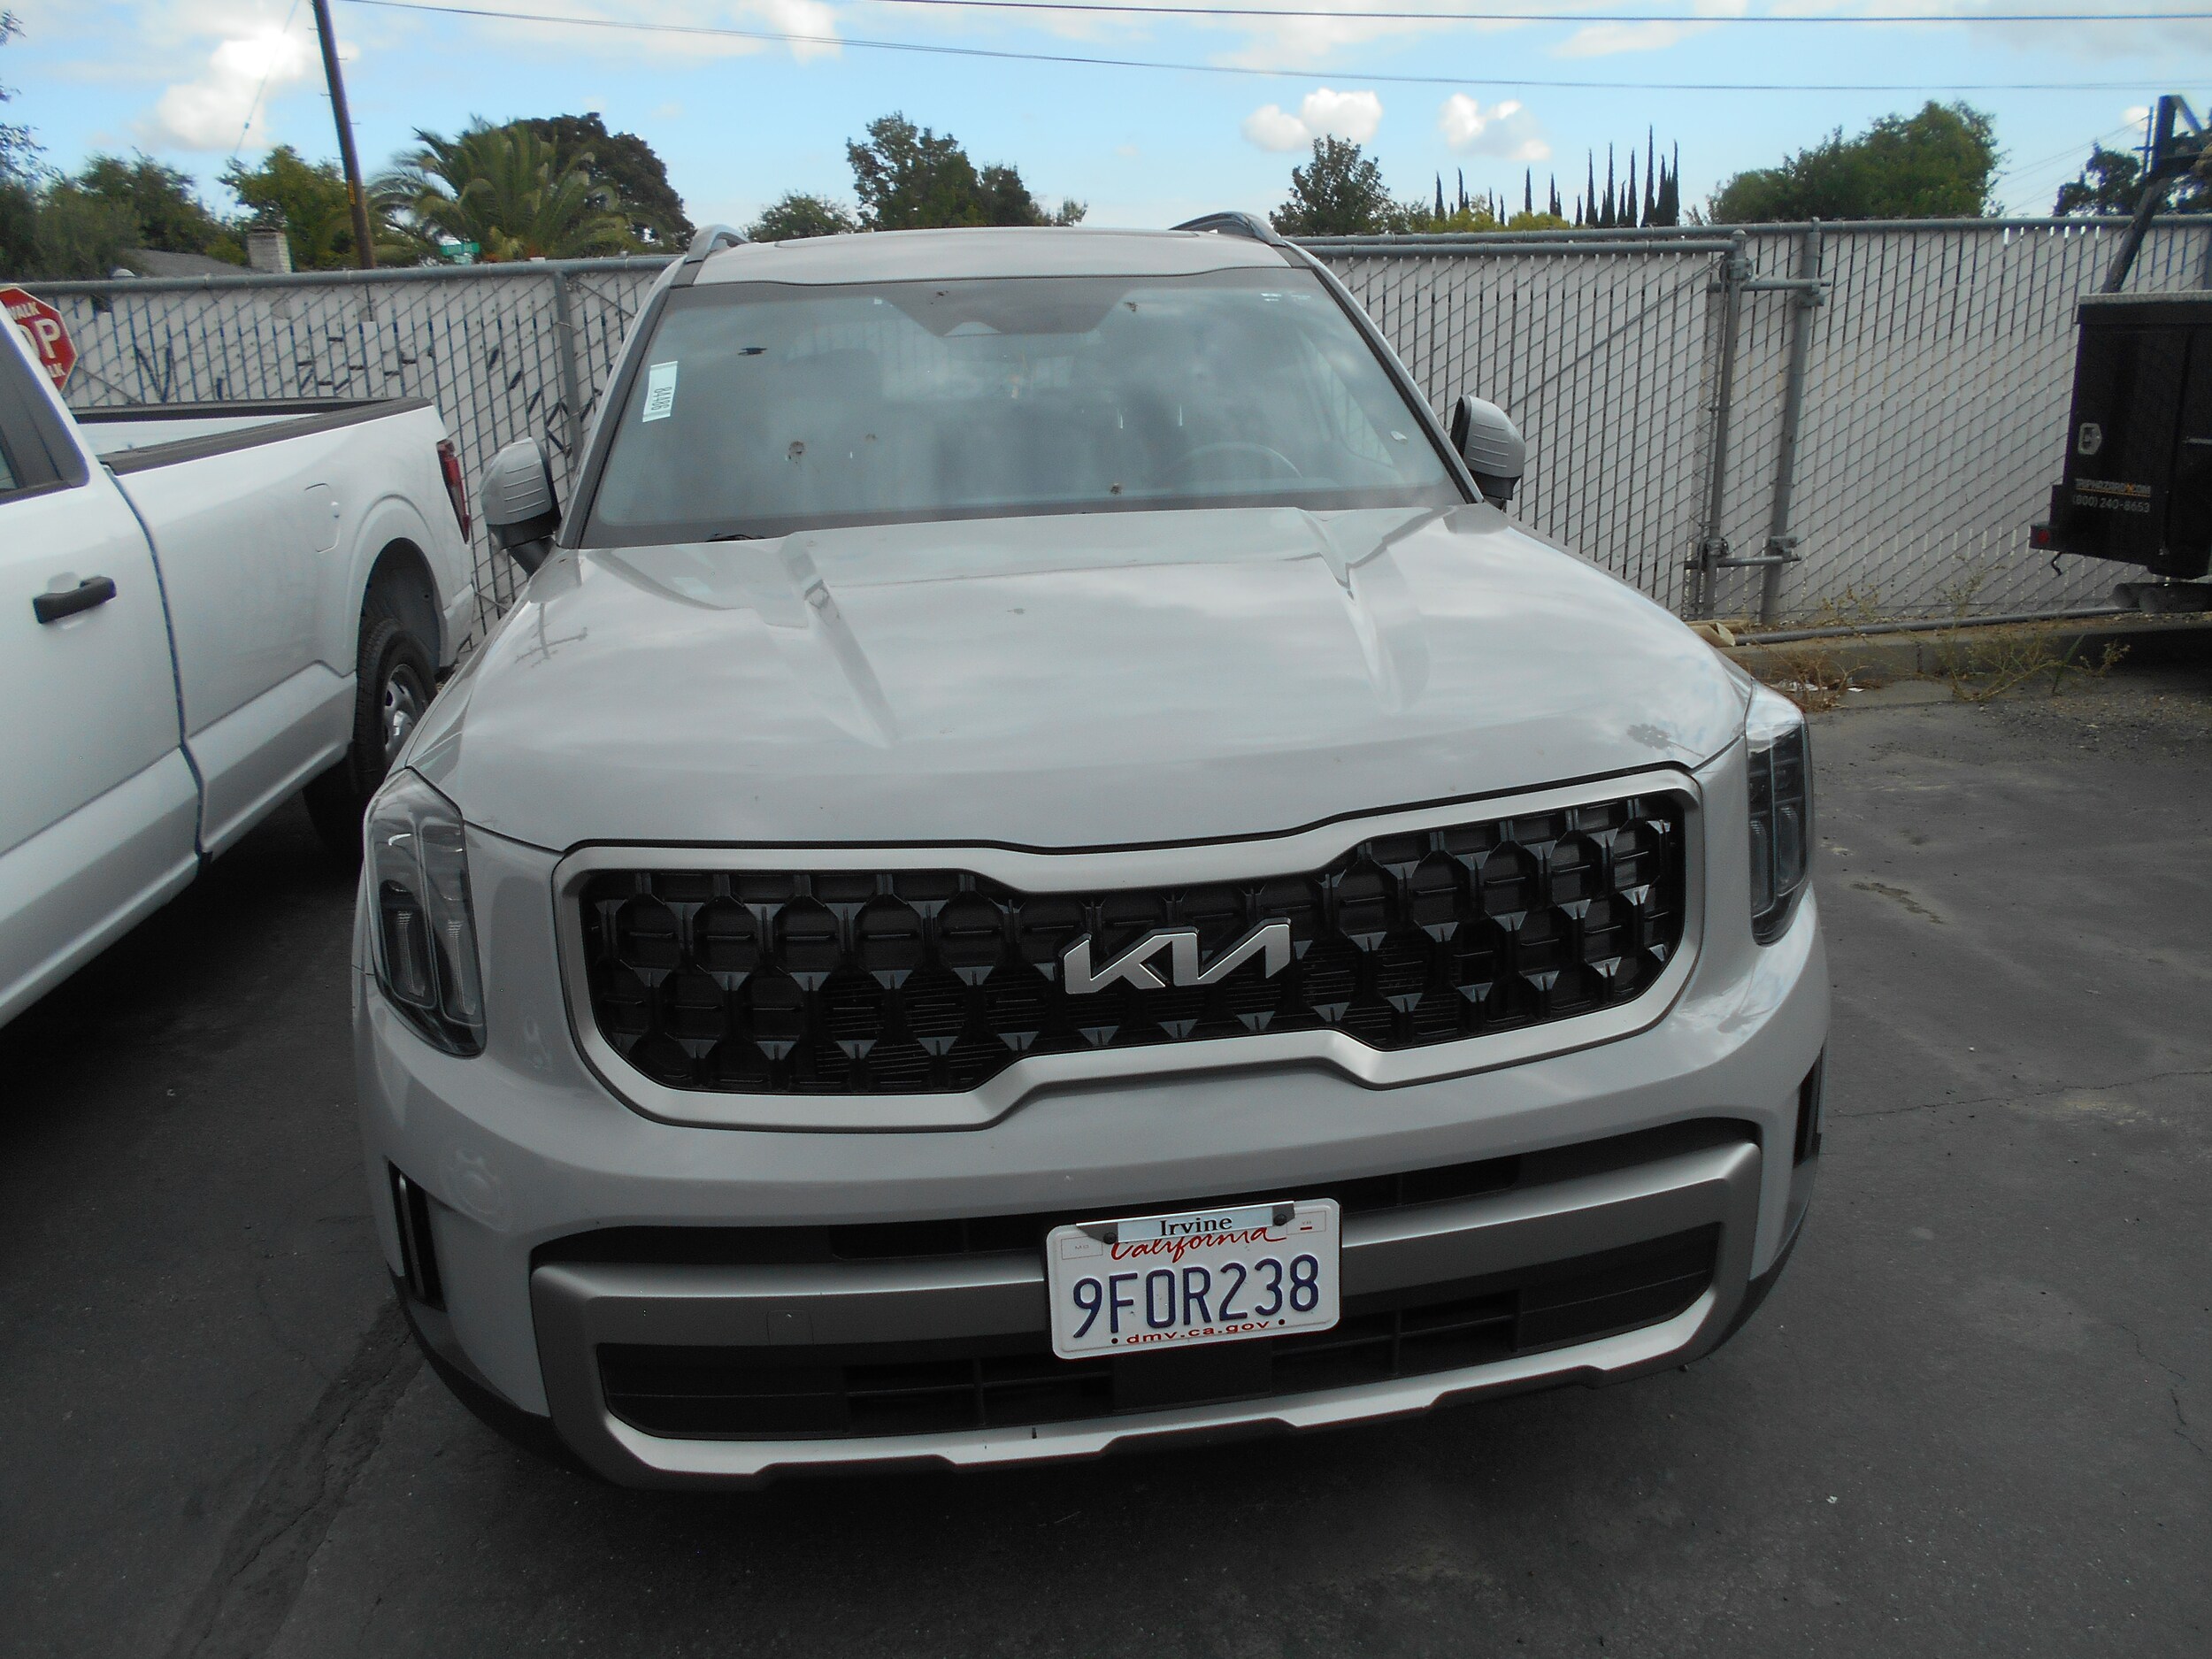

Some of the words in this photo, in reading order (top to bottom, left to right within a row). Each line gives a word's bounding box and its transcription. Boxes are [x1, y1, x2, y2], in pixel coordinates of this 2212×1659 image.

[1062, 918, 1291, 995] KIA
[1110, 1227, 1286, 1263] California
[1159, 1217, 1233, 1237] Irvine
[1072, 1254, 1319, 1339] 9FOR238
[1125, 1320, 1271, 1344] dmv.ca.gov
